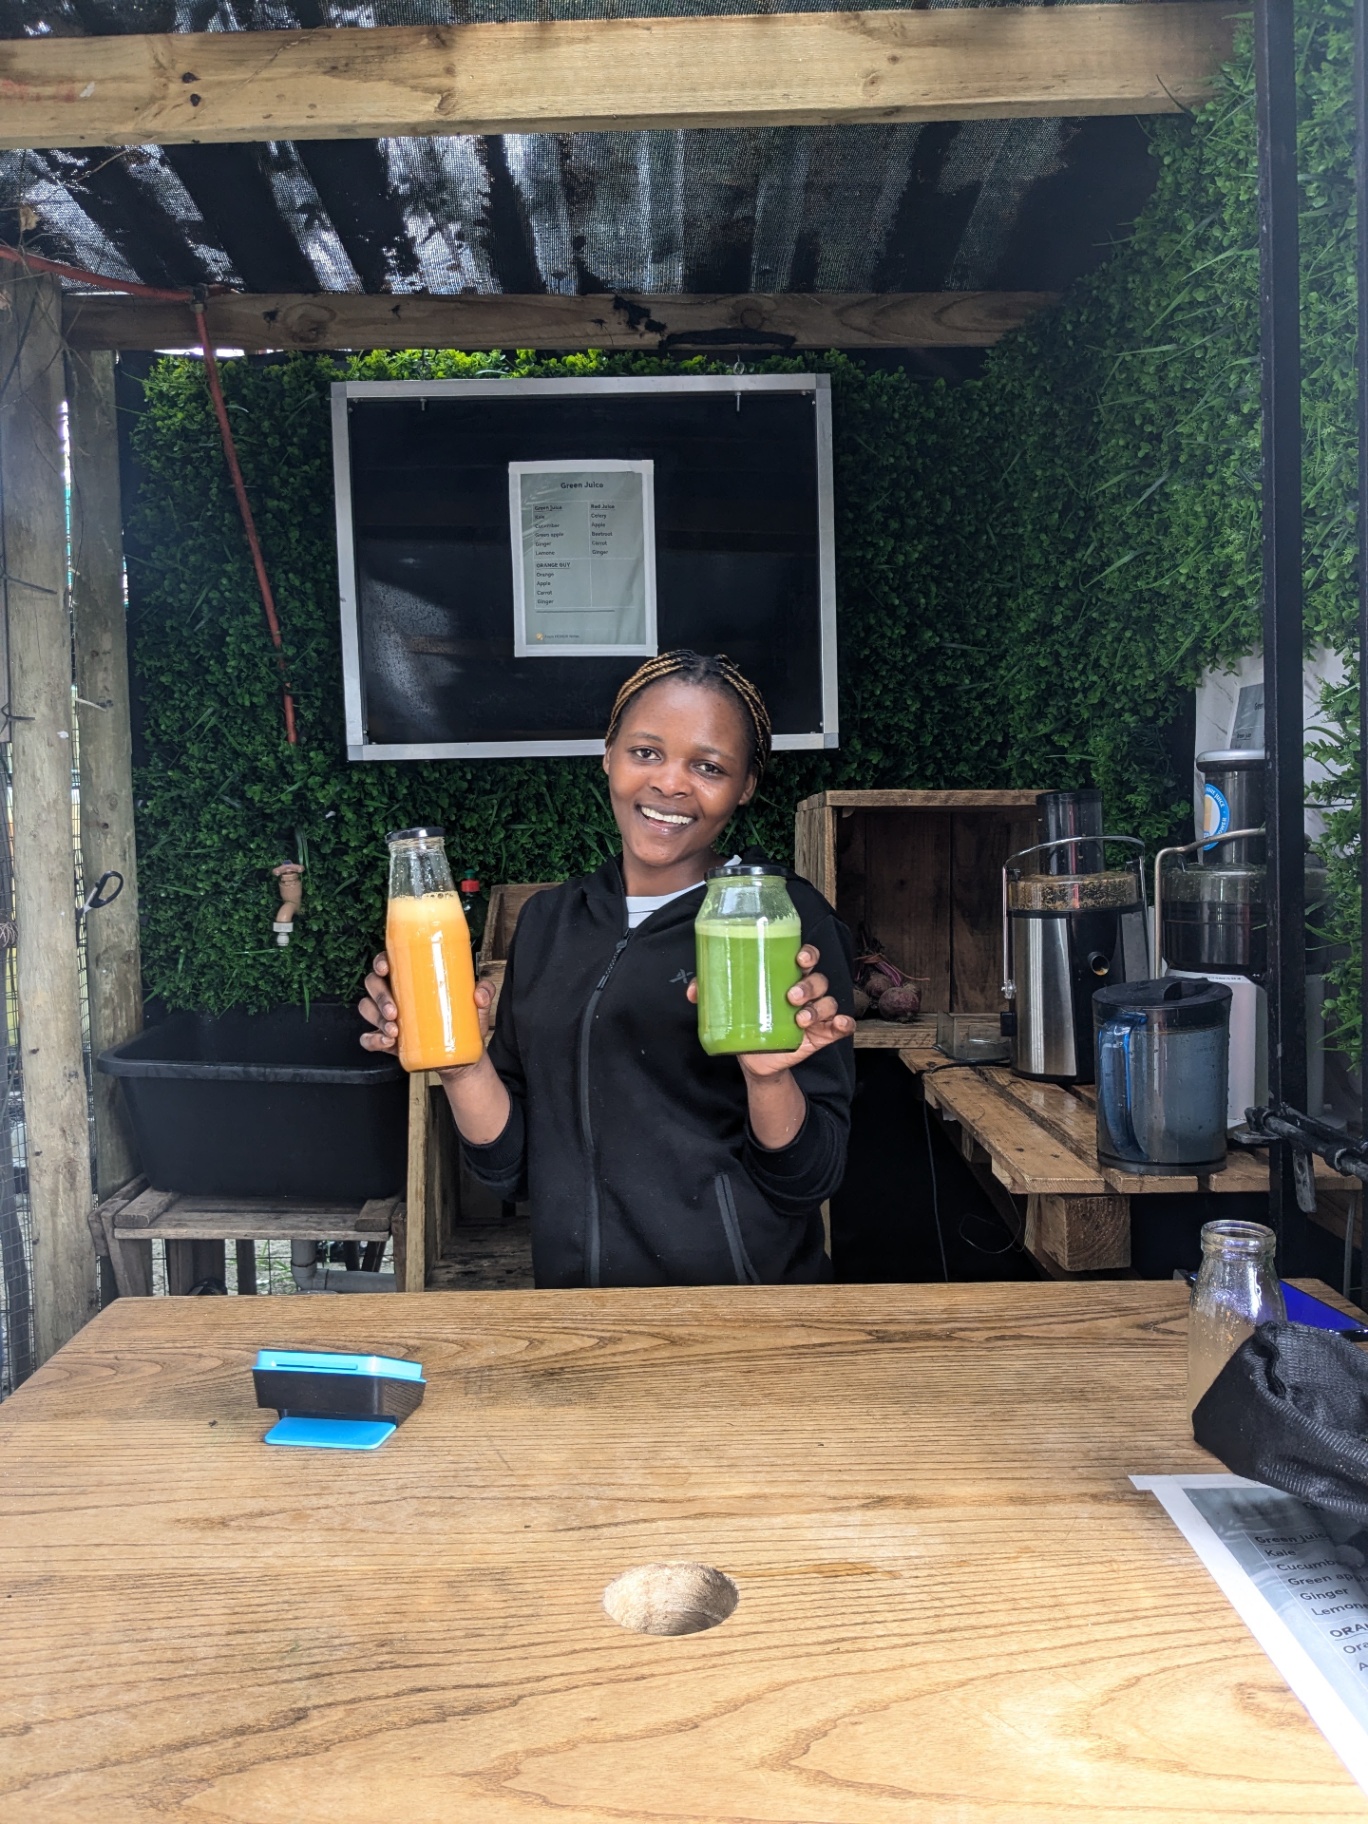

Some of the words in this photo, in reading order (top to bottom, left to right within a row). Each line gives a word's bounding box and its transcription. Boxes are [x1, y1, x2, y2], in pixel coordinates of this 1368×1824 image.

[1254, 1535, 1298, 1545] Green
[1264, 1549, 1297, 1557] Kale
[1288, 1575, 1333, 1586] Green
[1300, 1588, 1349, 1600] Ginger
